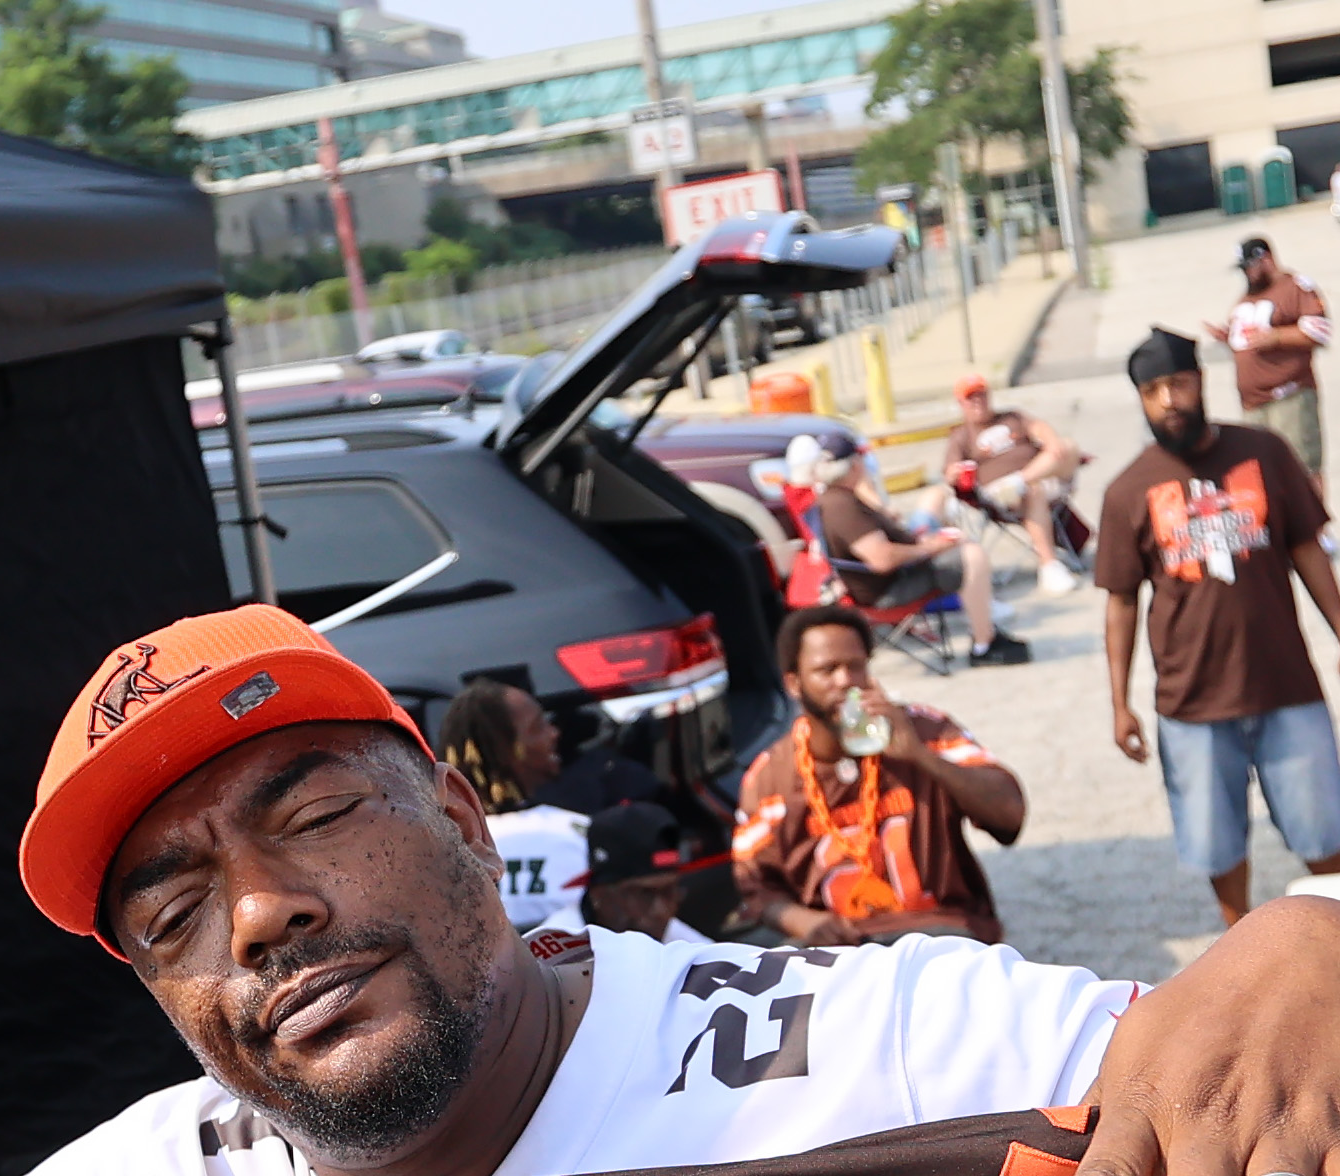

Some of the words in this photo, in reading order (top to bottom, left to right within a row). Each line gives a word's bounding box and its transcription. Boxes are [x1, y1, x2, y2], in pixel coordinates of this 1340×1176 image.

[689, 186, 756, 225] EXIT
[505, 857, 546, 895] TZ
[529, 934, 565, 960] 46
